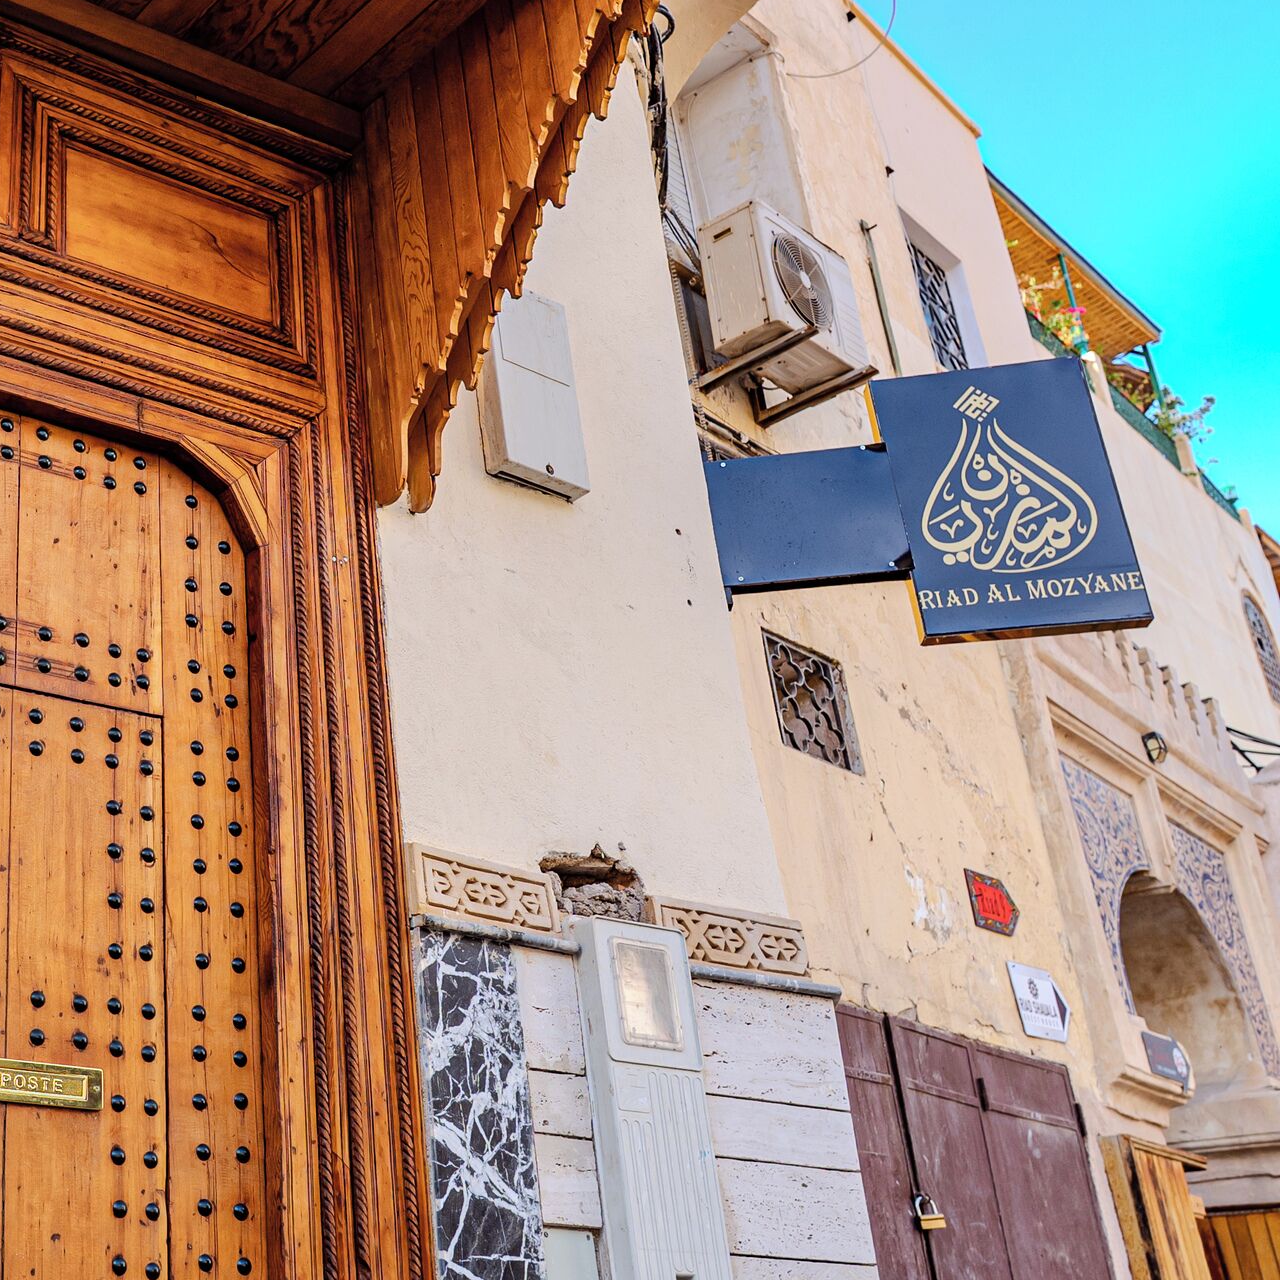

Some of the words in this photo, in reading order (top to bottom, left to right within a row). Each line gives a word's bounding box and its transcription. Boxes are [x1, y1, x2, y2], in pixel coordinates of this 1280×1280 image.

[919, 587, 980, 610] RIAD
[986, 583, 1021, 604] AL
[1025, 571, 1145, 600] MOZYANE
[0, 1073, 64, 1093] POSTE
